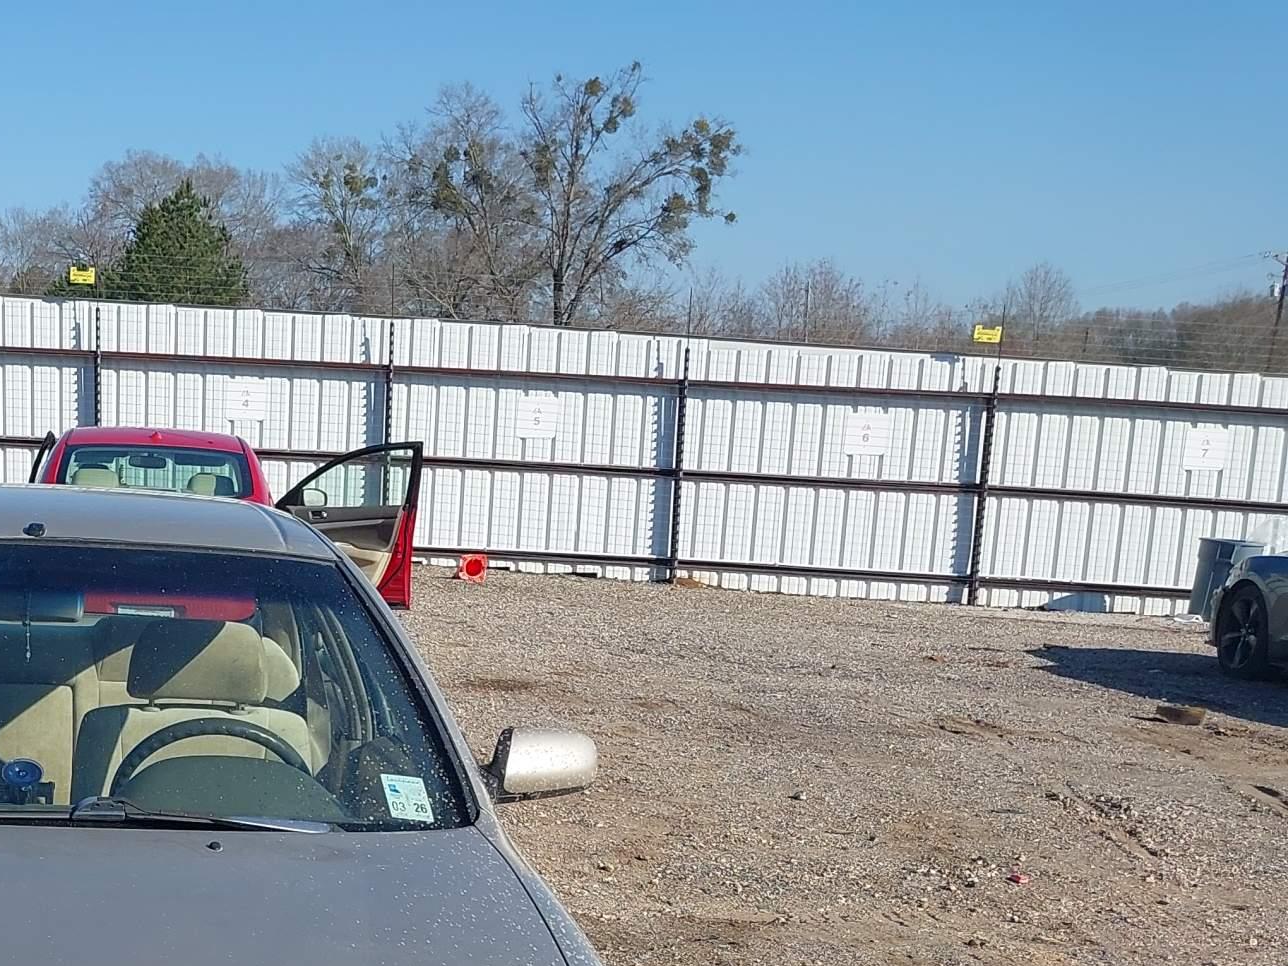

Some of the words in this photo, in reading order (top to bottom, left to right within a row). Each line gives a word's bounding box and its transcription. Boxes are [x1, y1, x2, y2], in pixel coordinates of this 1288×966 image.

[241, 400, 250, 408] 4
[533, 417, 541, 426] 5
[862, 433, 870, 442] 6
[1201, 448, 1209, 458] 7
[392, 801, 406, 812] 03
[413, 803, 428, 814] 26
